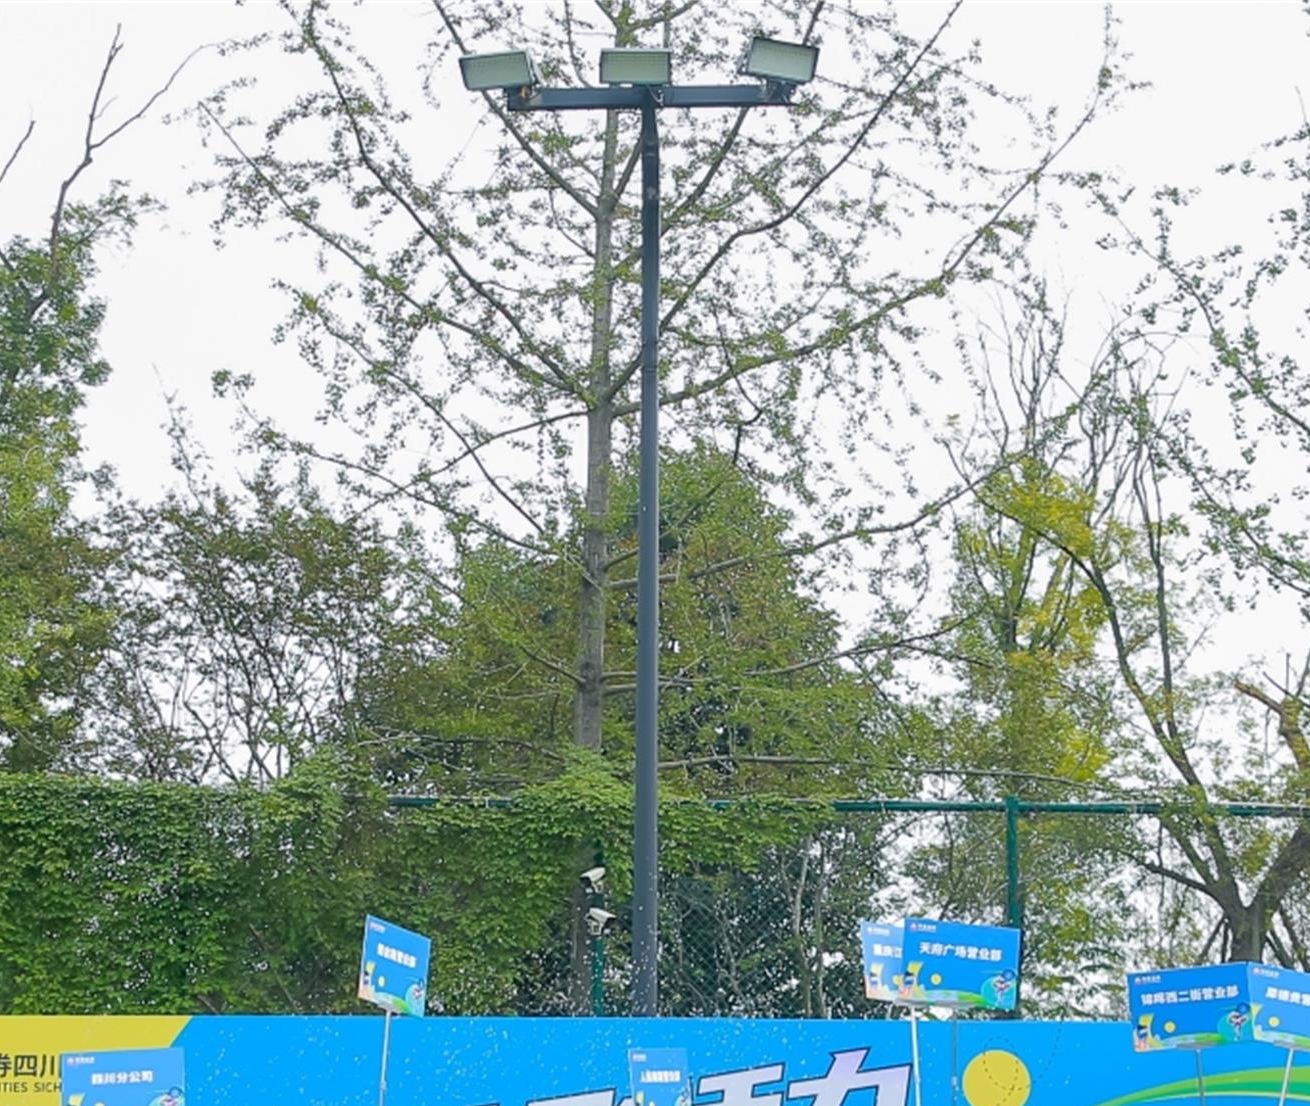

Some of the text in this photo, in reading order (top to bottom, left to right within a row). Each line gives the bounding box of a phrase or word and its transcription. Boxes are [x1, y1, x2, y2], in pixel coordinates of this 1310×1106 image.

[919, 942, 1002, 962] 天府广场营业部
[91, 1070, 153, 1085] 四川分公司
